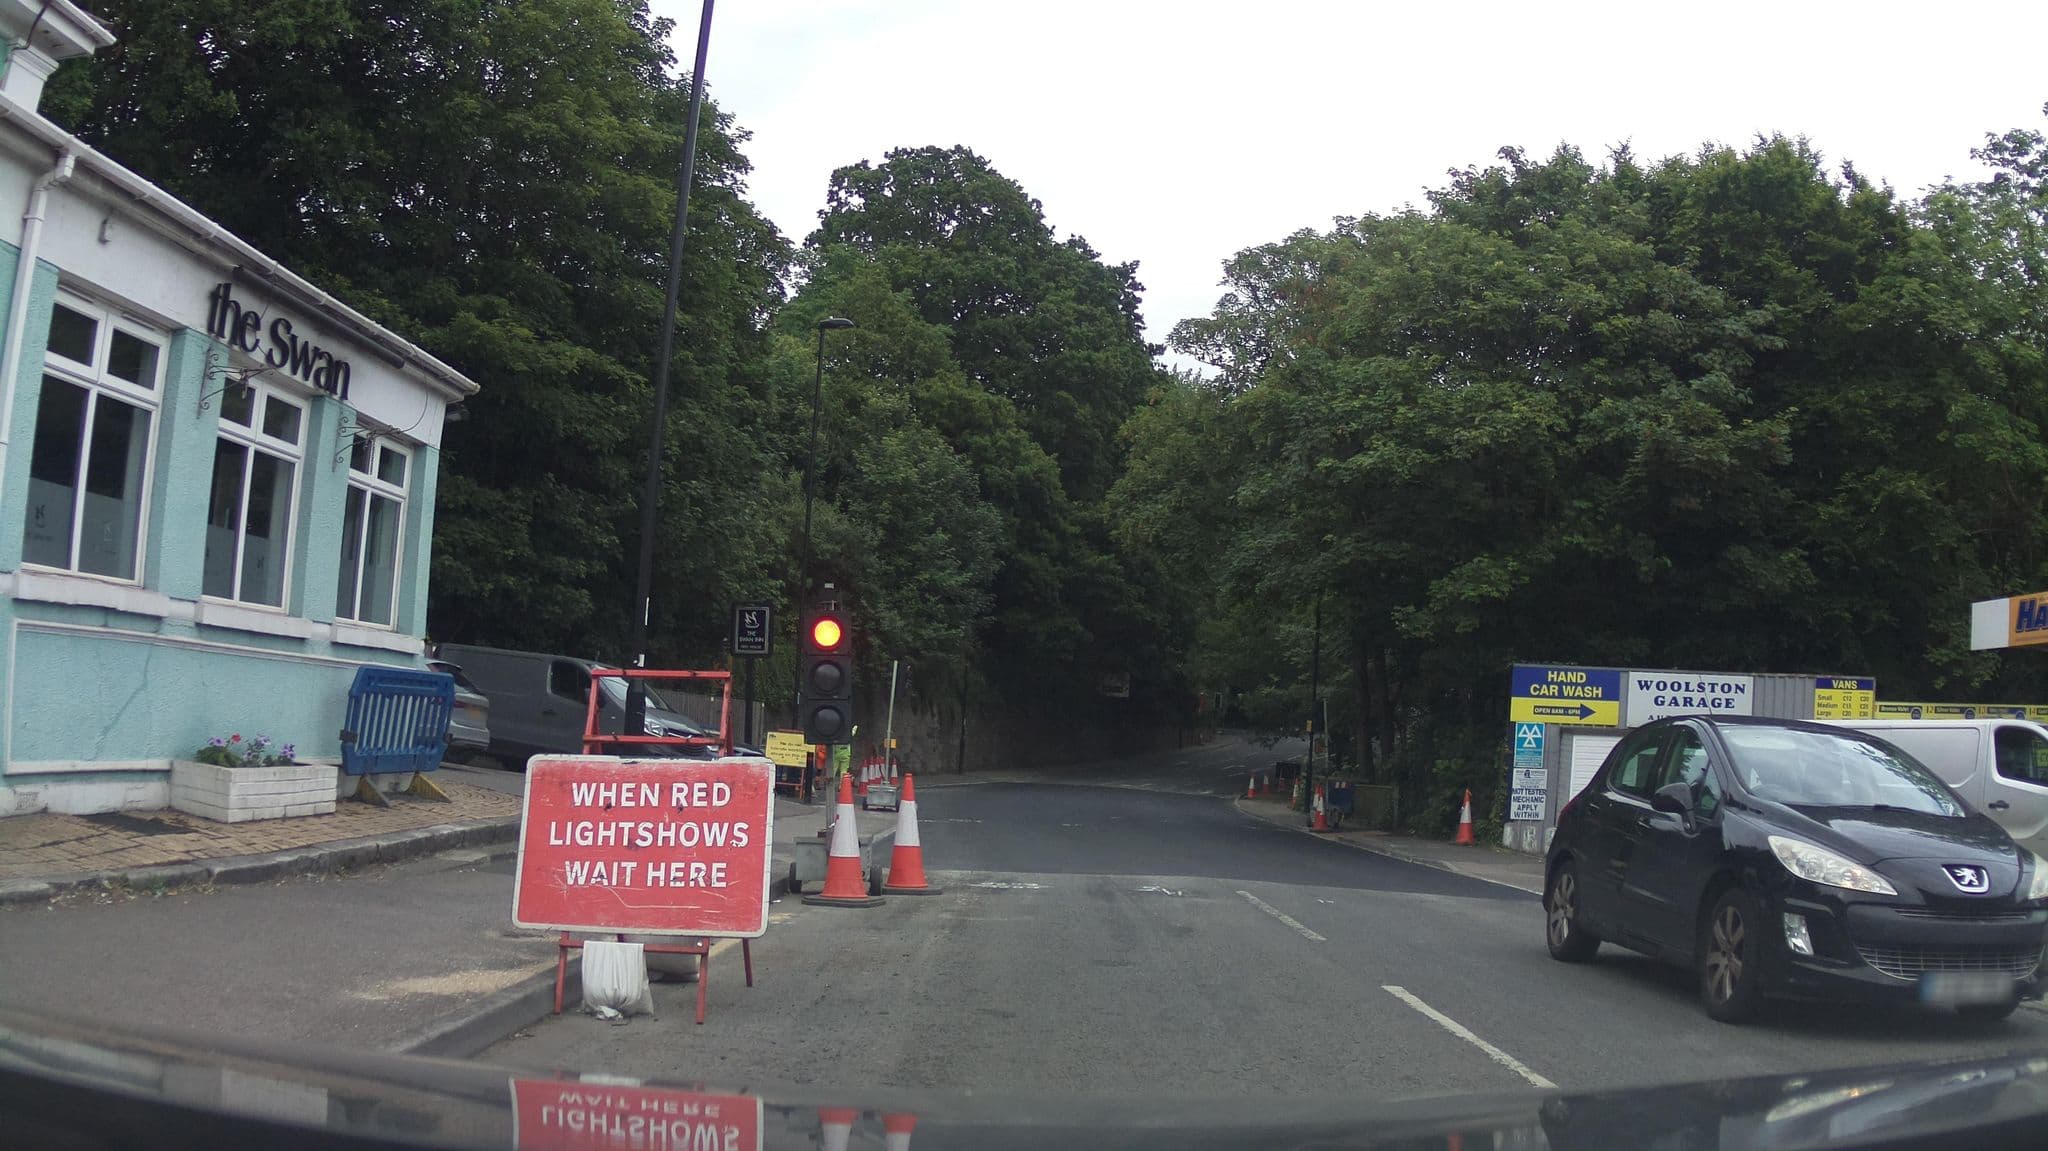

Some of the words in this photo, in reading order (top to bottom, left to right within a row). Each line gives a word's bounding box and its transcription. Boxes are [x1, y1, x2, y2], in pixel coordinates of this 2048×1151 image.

[207, 282, 261, 353] the
[265, 317, 351, 401] Swan
[1547, 671, 1587, 683] HAND
[1832, 679, 1857, 689] VANS
[1530, 684, 1558, 697] CAR
[1563, 685, 1602, 698] WASH
[1637, 679, 1746, 694] WOOLSTON
[1654, 695, 1735, 708] GARAGE
[572, 782, 660, 808] WHEN
[671, 782, 731, 808] RED
[1513, 795, 1544, 804] MECHANIC
[565, 861, 637, 886] WAIT
[647, 862, 728, 888] HERE
